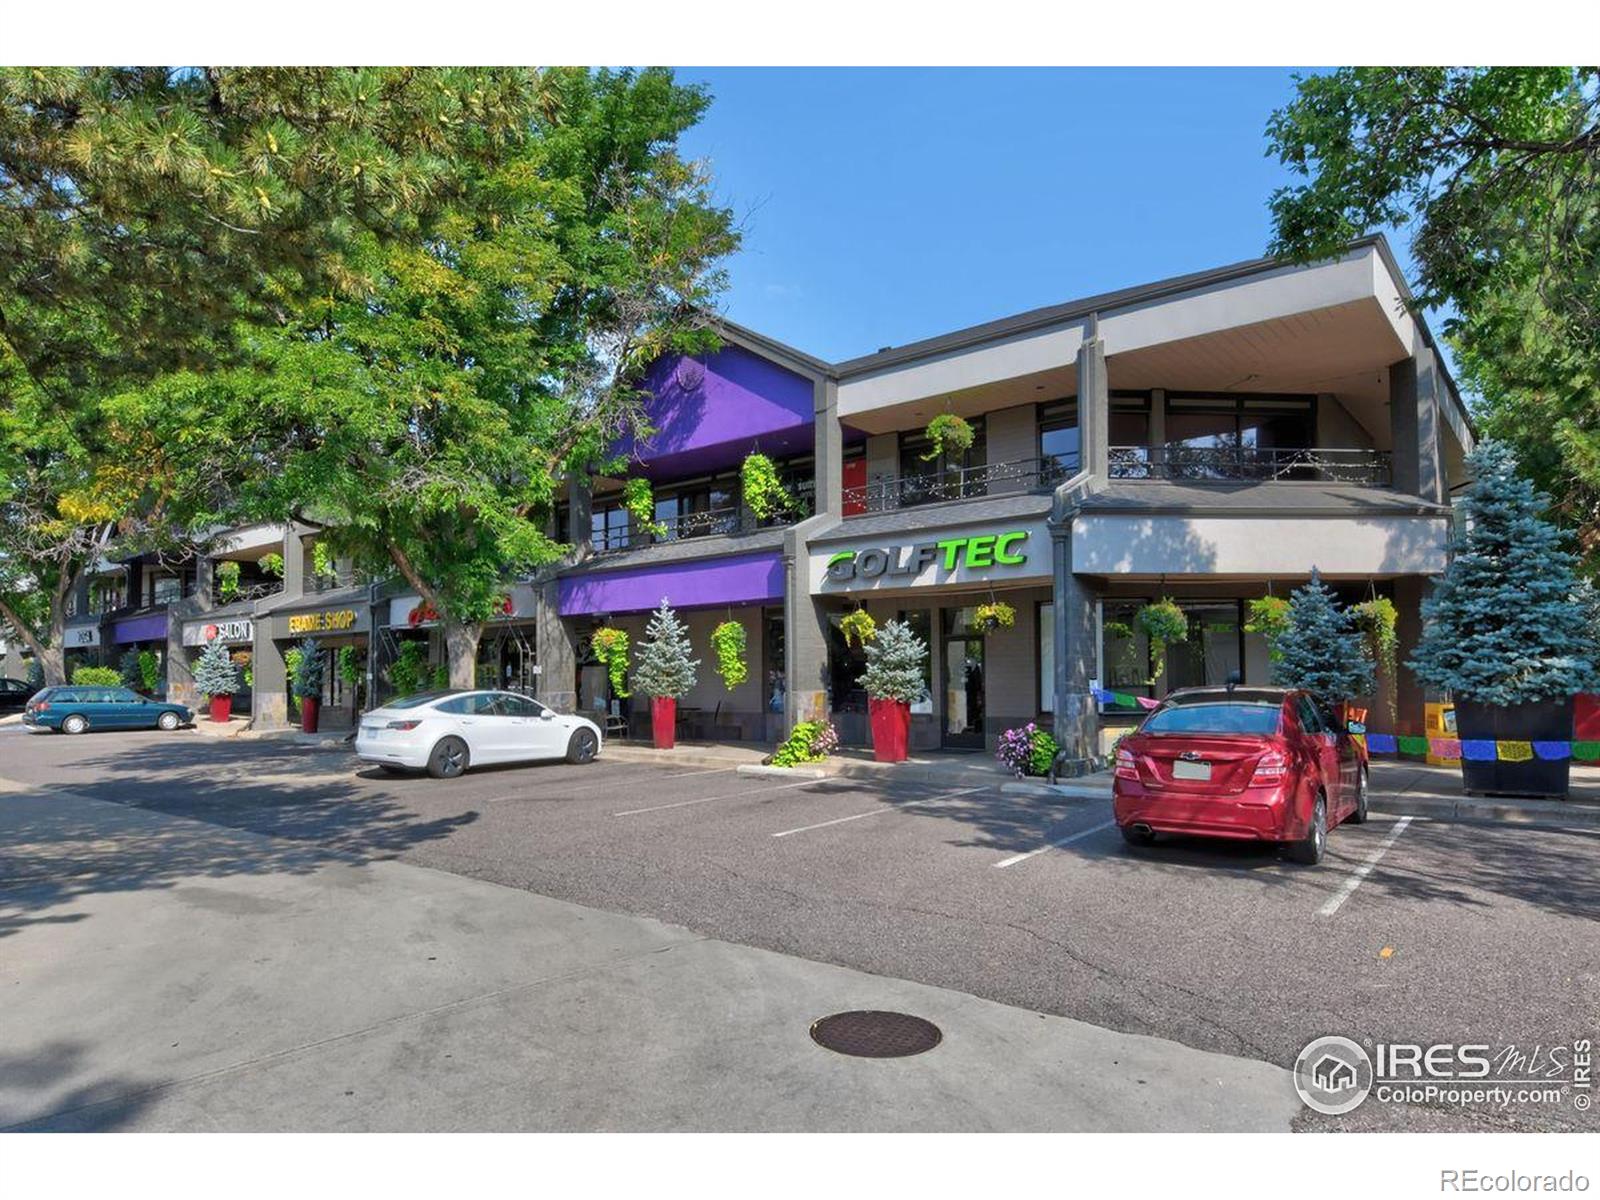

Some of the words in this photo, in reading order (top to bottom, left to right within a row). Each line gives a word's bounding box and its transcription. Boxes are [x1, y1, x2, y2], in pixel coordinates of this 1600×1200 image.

[826, 530, 1029, 582] GOLFTEC
[219, 620, 251, 641] SALON
[325, 610, 354, 630] SHOP
